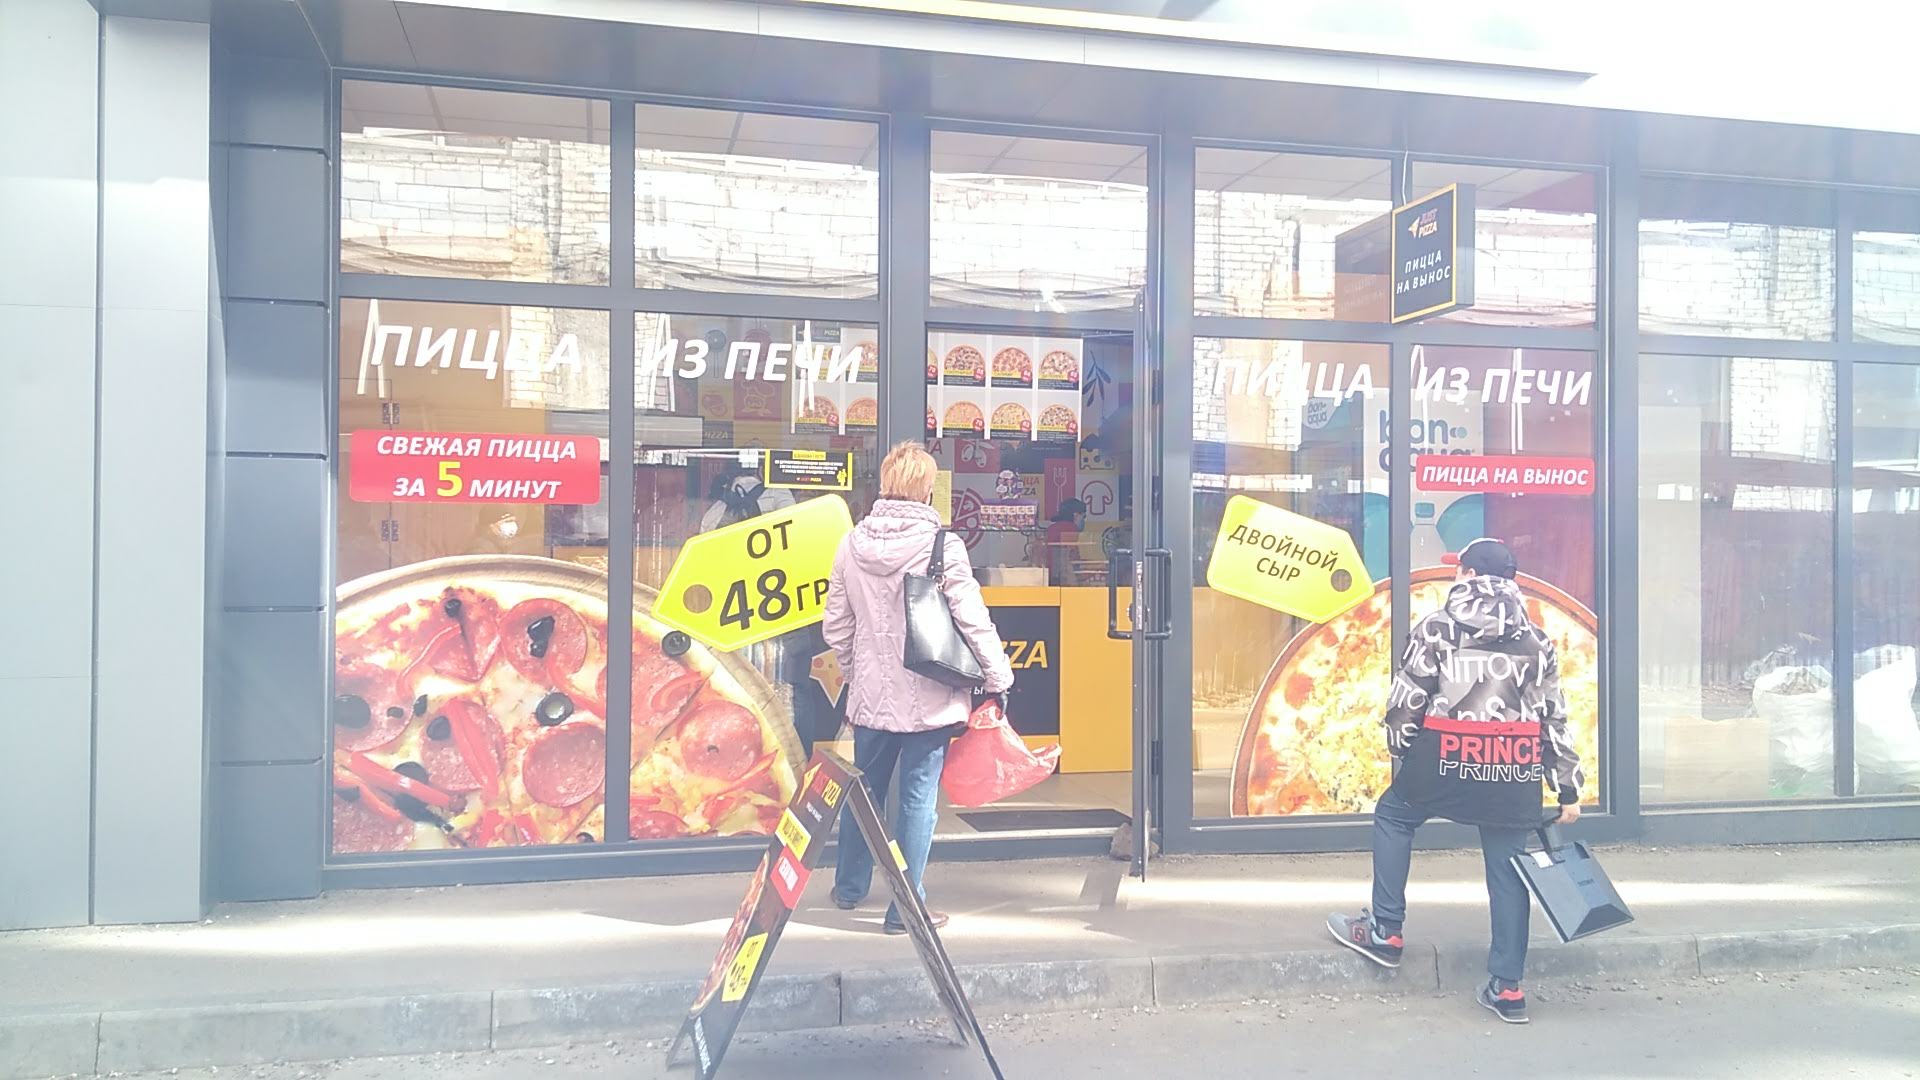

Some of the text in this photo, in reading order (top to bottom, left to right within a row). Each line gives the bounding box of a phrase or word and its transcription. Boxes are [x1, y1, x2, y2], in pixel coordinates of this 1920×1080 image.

[1418, 221, 1438, 238] PIZZA
[1405, 249, 1442, 274] ПИЦЦА
[1396, 281, 1420, 295] НА
[1412, 265, 1451, 289] ВЫНОС
[371, 324, 864, 383] ПИЦЦА ИЗ ПЕЧИ
[1213, 359, 1593, 406] ПИЦЦА ИЗ ПЕЧИ
[377, 435, 577, 462] СВЕЖАЯ ПИЦЦА
[393, 460, 562, 499] ЗА 5 МИНУТ
[1422, 466, 1589, 486] ПИЦЦА НА ВЫНОС
[746, 519, 793, 559] ОТ
[1227, 524, 1339, 572] ДВОЙНОЙ
[1256, 557, 1301, 581] СЫР
[1440, 733, 1542, 764] PRINCE
